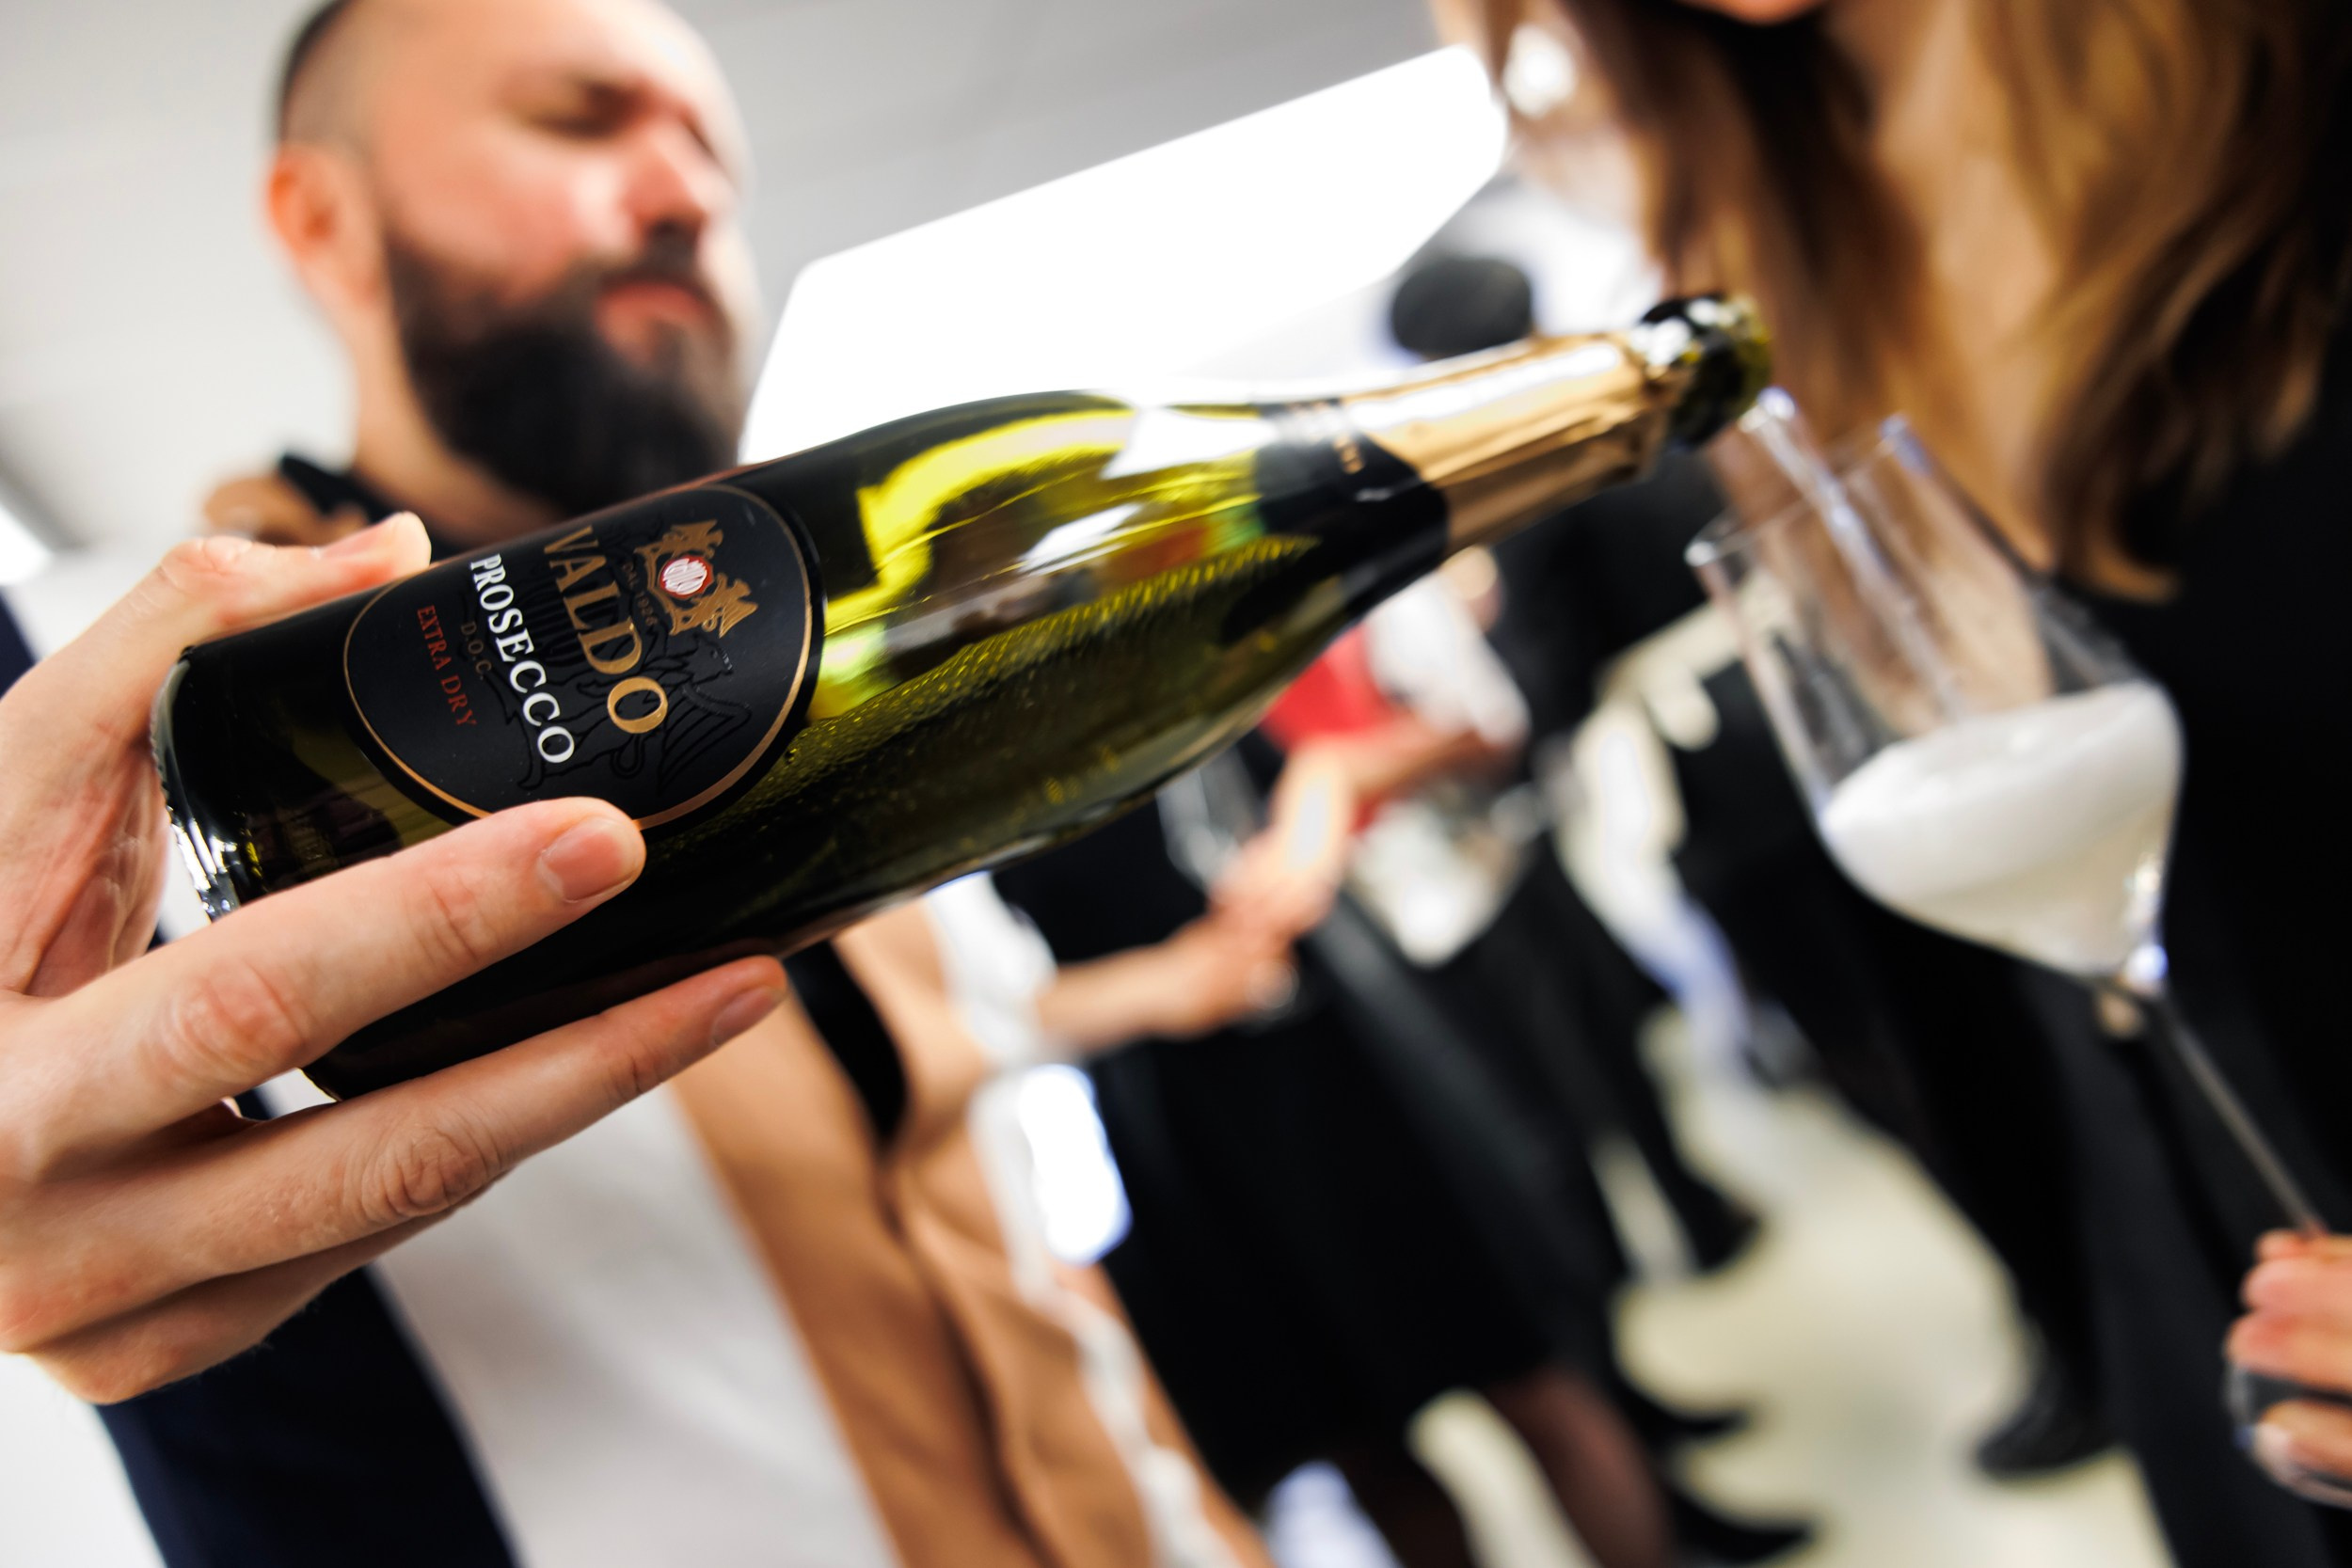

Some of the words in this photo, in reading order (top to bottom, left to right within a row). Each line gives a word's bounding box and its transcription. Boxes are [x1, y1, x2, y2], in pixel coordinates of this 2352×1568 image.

[544, 526, 668, 734] VALDO
[621, 562, 640, 589] DAL
[417, 604, 452, 672] EXTRA
[441, 674, 477, 727] DRY
[469, 553, 575, 764] PROSECCO
